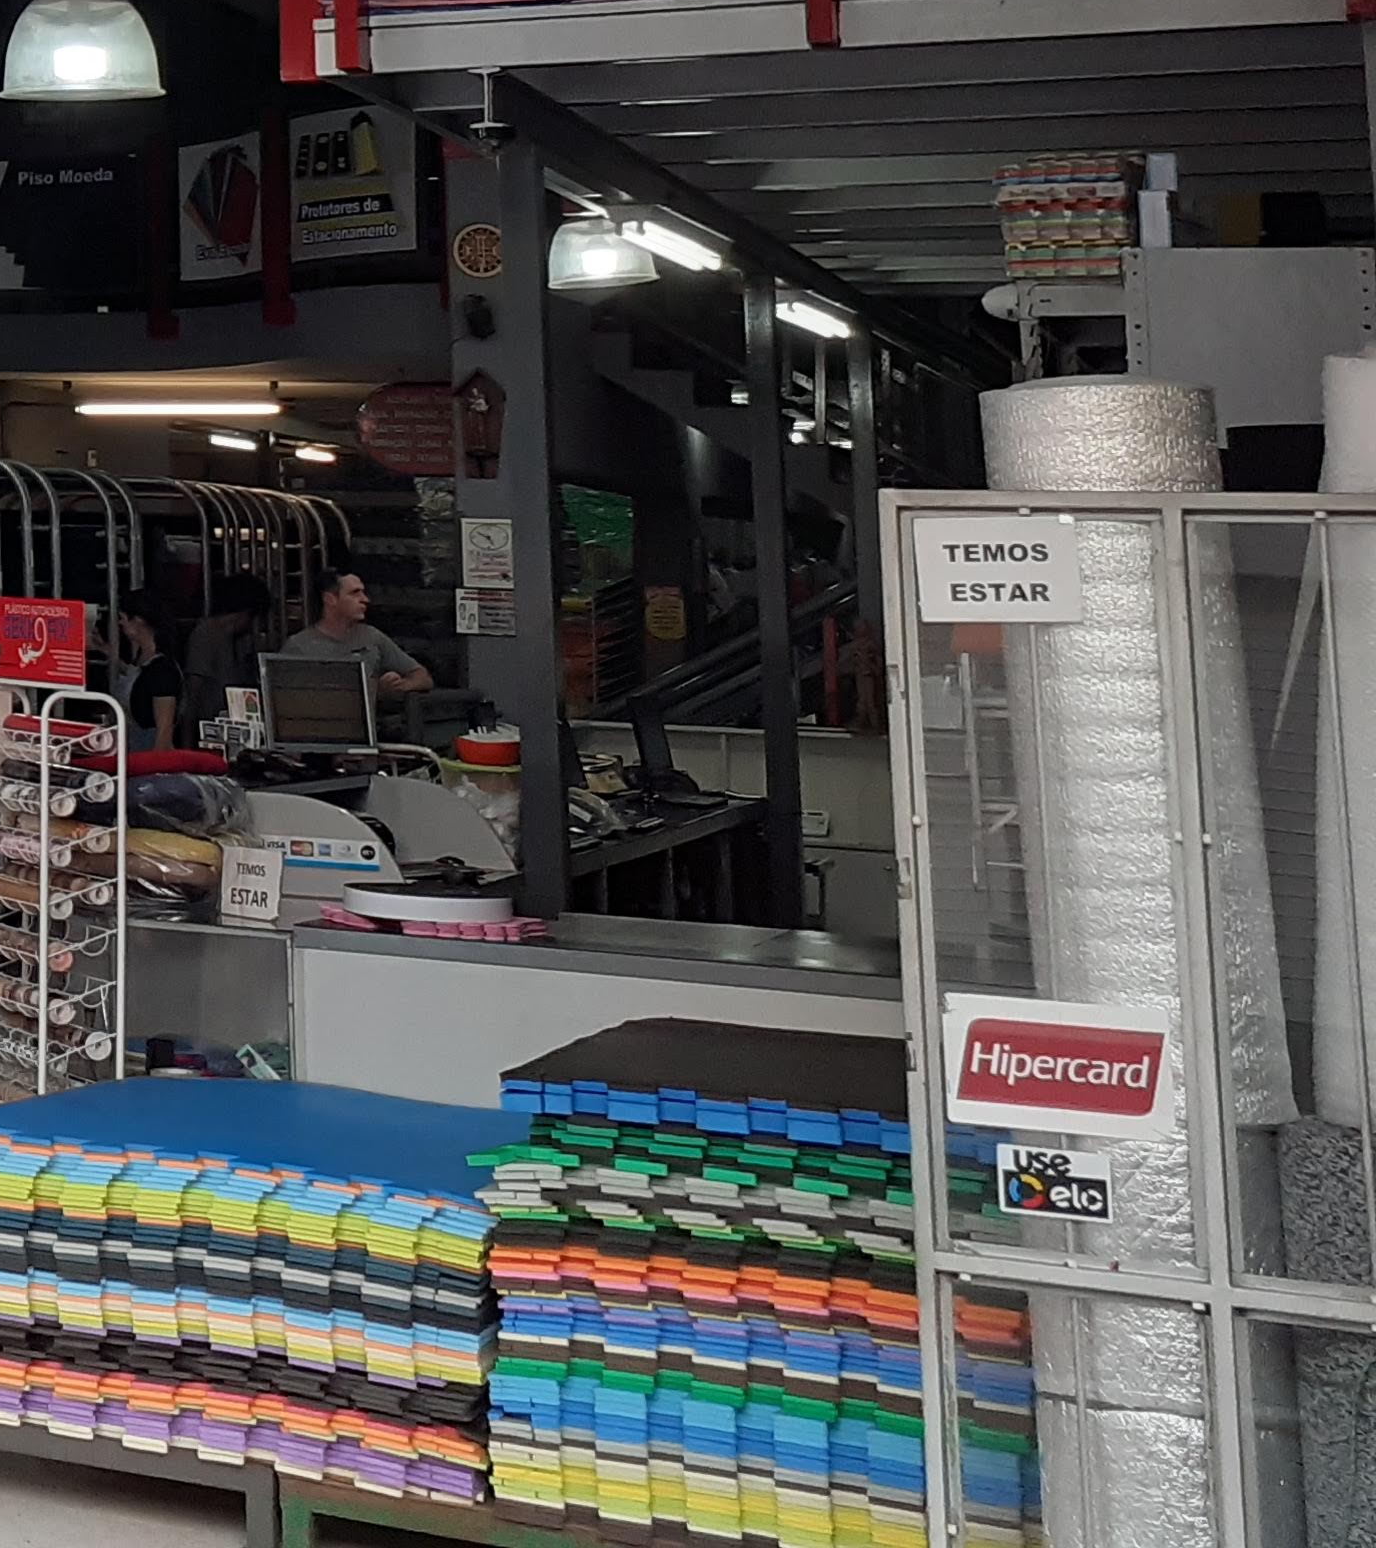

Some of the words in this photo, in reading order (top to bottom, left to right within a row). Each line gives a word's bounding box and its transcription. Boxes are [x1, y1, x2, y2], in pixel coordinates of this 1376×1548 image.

[17, 171, 54, 186] Piso
[59, 168, 114, 185] Moeda
[299, 200, 360, 221] Protetores
[362, 198, 381, 213] de
[301, 222, 398, 245] Estacionamento
[942, 542, 1049, 563] TEMOS
[950, 582, 1051, 603] ESTAR
[235, 862, 267, 877] TEMOS
[230, 888, 269, 909] ESTAR
[970, 1040, 1151, 1089] Hipercard
[1012, 1149, 1072, 1174] use
[1049, 1183, 1104, 1212] elo
